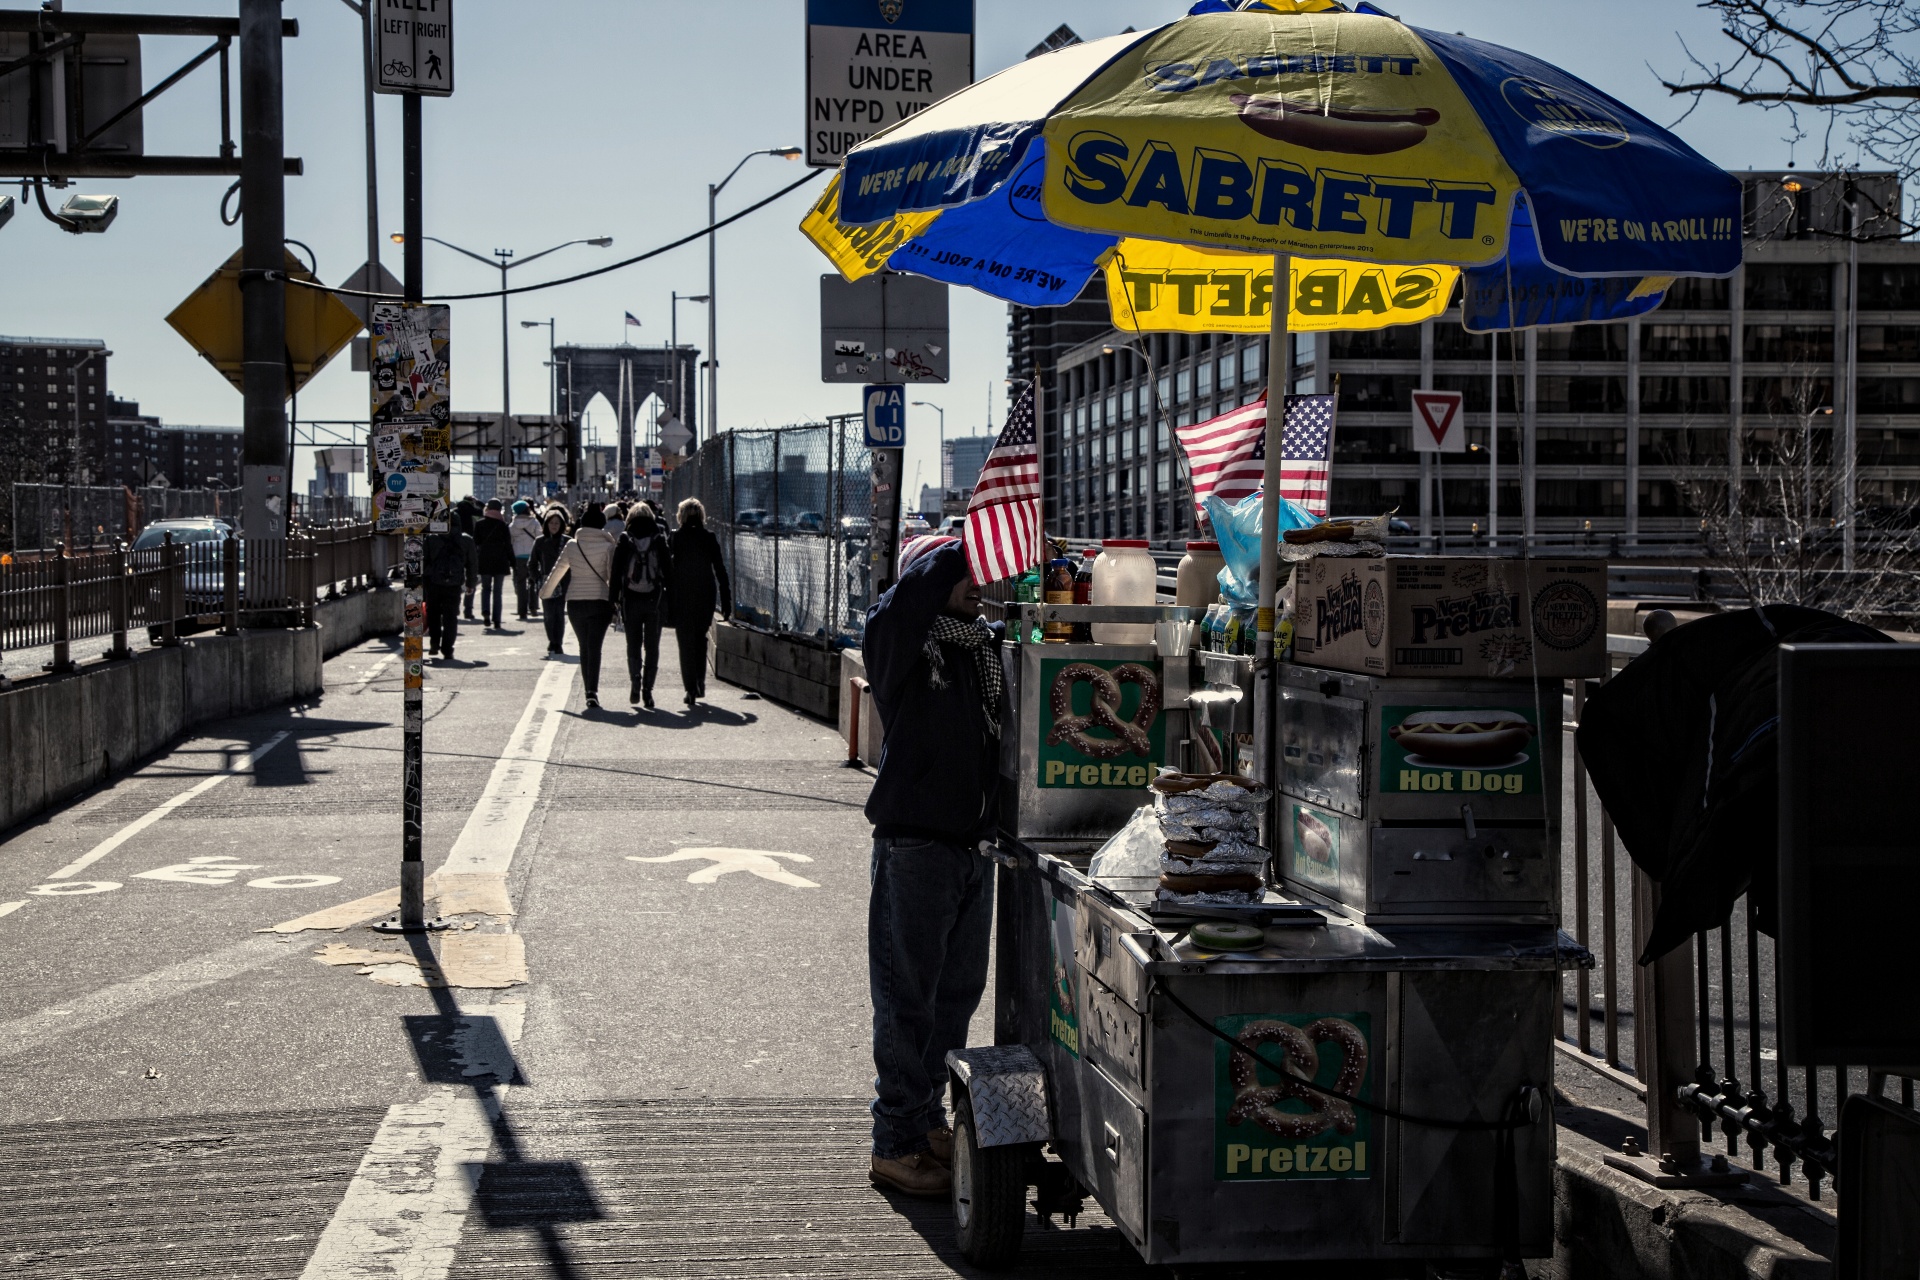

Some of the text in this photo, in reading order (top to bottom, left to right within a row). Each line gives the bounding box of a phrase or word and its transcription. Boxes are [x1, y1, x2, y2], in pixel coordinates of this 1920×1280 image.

[384, 19, 409, 35] LEFT
[417, 22, 446, 38] RIGHT
[855, 33, 927, 59] AREA
[849, 65, 932, 93] UNDER
[1144, 53, 1420, 93] SABRETT
[815, 97, 884, 124] NYPD
[858, 166, 906, 197] WE'RE
[1064, 130, 1497, 239] SABRETT
[1204, 231, 1232, 239] Umbrella
[1252, 235, 1279, 245] Property
[1287, 239, 1318, 249] Marathon
[1560, 217, 1732, 243] WE'RE ON A ROLL !!!
[888, 390, 902, 442] AID
[498, 469, 515, 478] KEEP
[1326, 585, 1342, 611] New
[1436, 596, 1472, 617] New
[1550, 603, 1583, 611] NEW YORK
[1315, 580, 1363, 650] Pretzel
[1411, 593, 1521, 644] Pretzel
[1547, 612, 1583, 620] PRETZEL
[1045, 760, 1158, 786] Pretzel
[1400, 770, 1523, 794] Hot Dog
[1051, 1007, 1079, 1055] Pretzel
[1226, 1141, 1366, 1174] Pretzel
